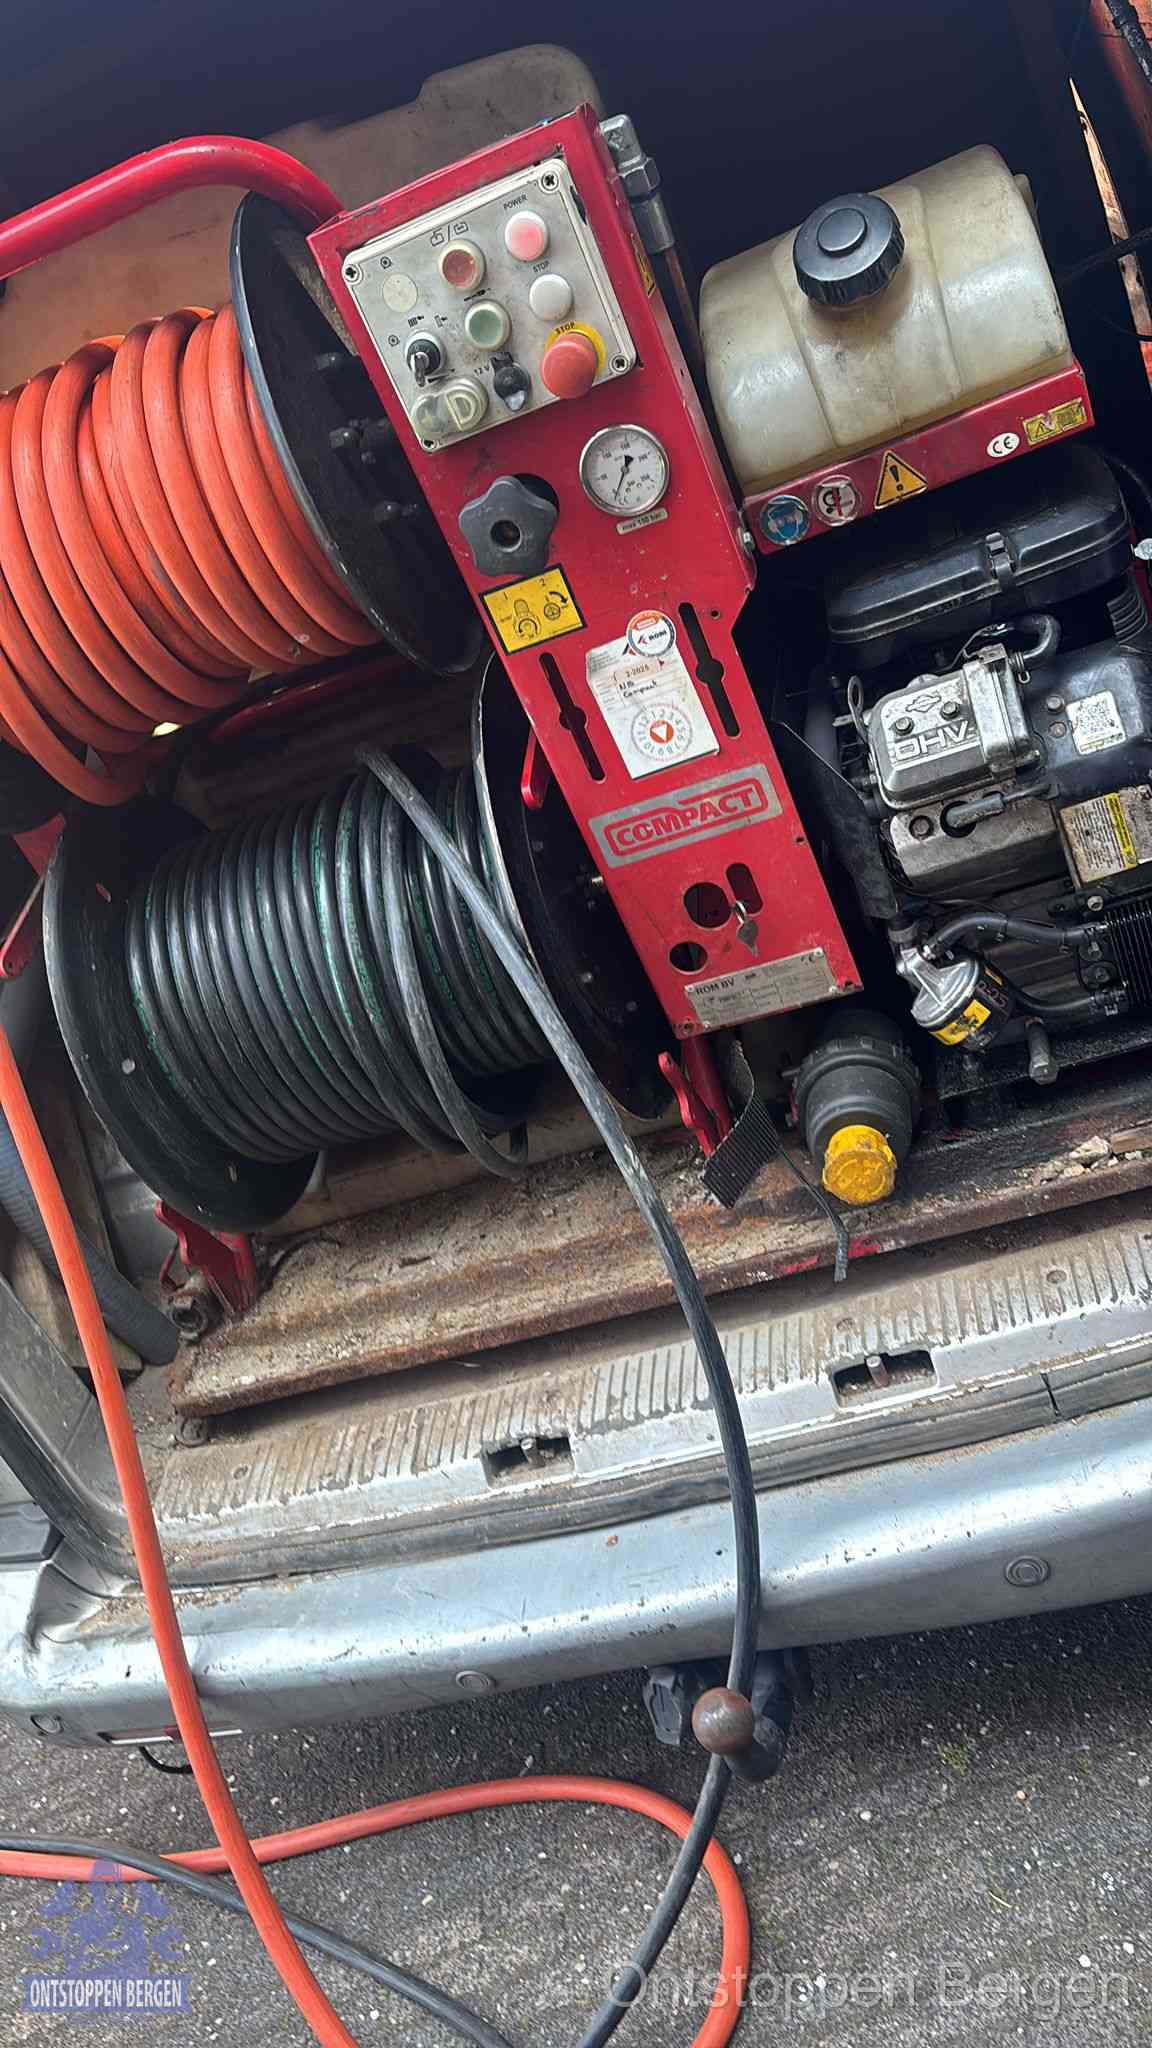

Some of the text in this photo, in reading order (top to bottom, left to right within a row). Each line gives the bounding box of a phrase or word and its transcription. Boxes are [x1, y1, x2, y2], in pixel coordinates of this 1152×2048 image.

[503, 194, 528, 210] POWER
[533, 261, 550, 273] STOP
[555, 322, 576, 335] STOP
[992, 434, 1012, 454] CE
[615, 786, 754, 847] COMPACT
[696, 980, 720, 995] ROM
[721, 977, 735, 989] BV
